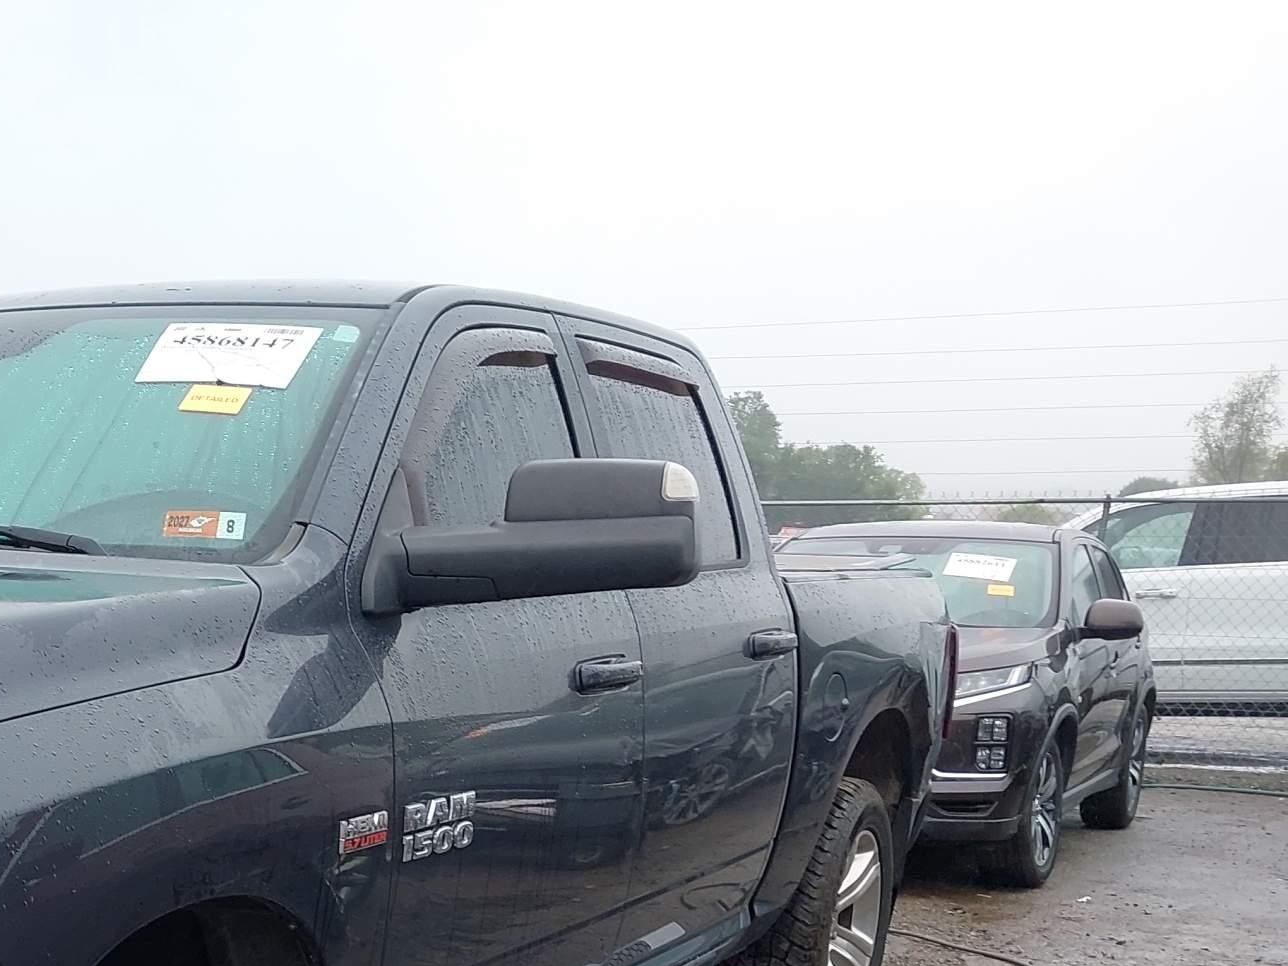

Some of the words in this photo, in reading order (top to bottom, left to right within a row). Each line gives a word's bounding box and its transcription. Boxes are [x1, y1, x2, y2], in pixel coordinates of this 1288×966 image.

[173, 335, 295, 349] 45868147
[167, 515, 191, 528] 2027
[226, 519, 236, 533] 8
[403, 791, 476, 832] RAM
[339, 810, 388, 838] HEMI
[402, 821, 474, 863] 1500
